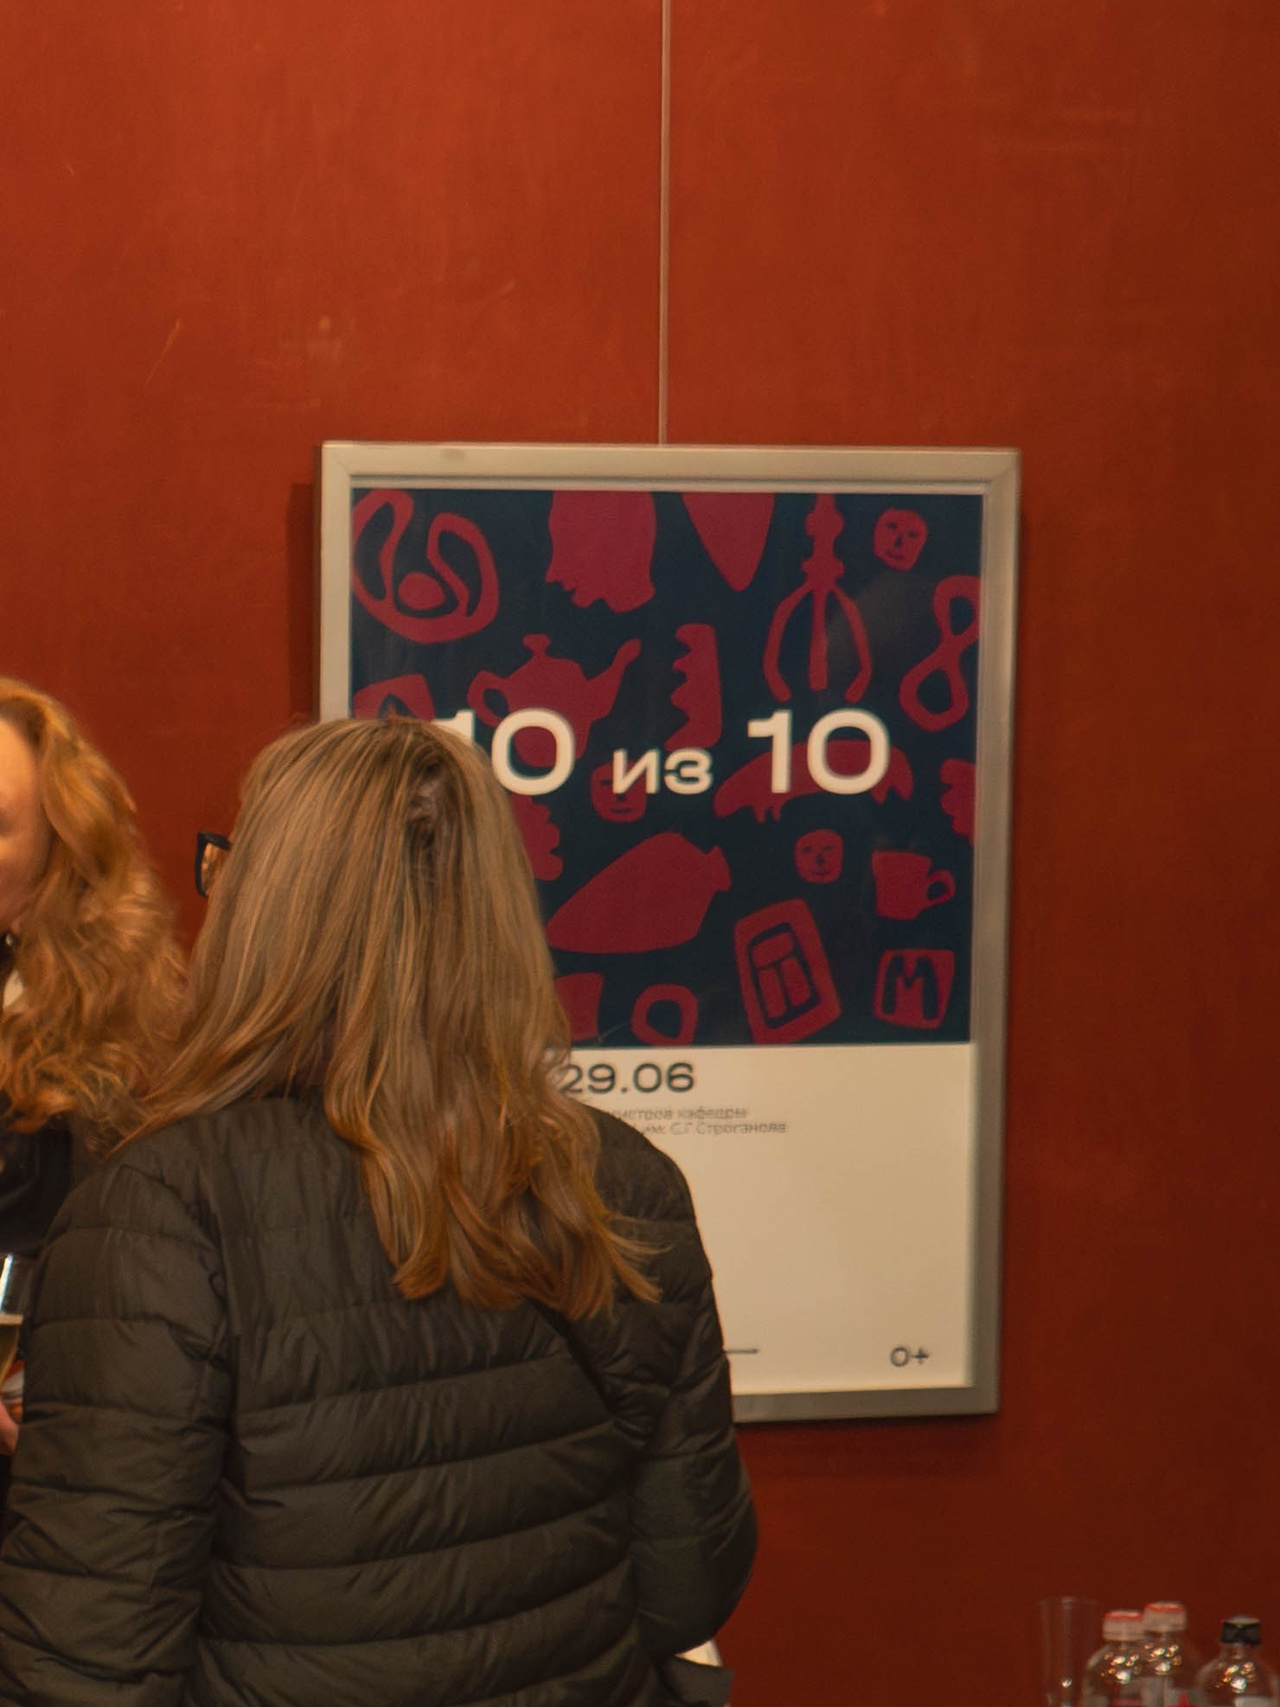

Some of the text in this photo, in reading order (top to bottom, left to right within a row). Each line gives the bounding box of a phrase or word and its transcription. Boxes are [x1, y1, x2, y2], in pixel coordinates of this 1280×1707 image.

[611, 748, 712, 795] из
[747, 708, 890, 795] 10
[889, 1346, 930, 1368] 0+
